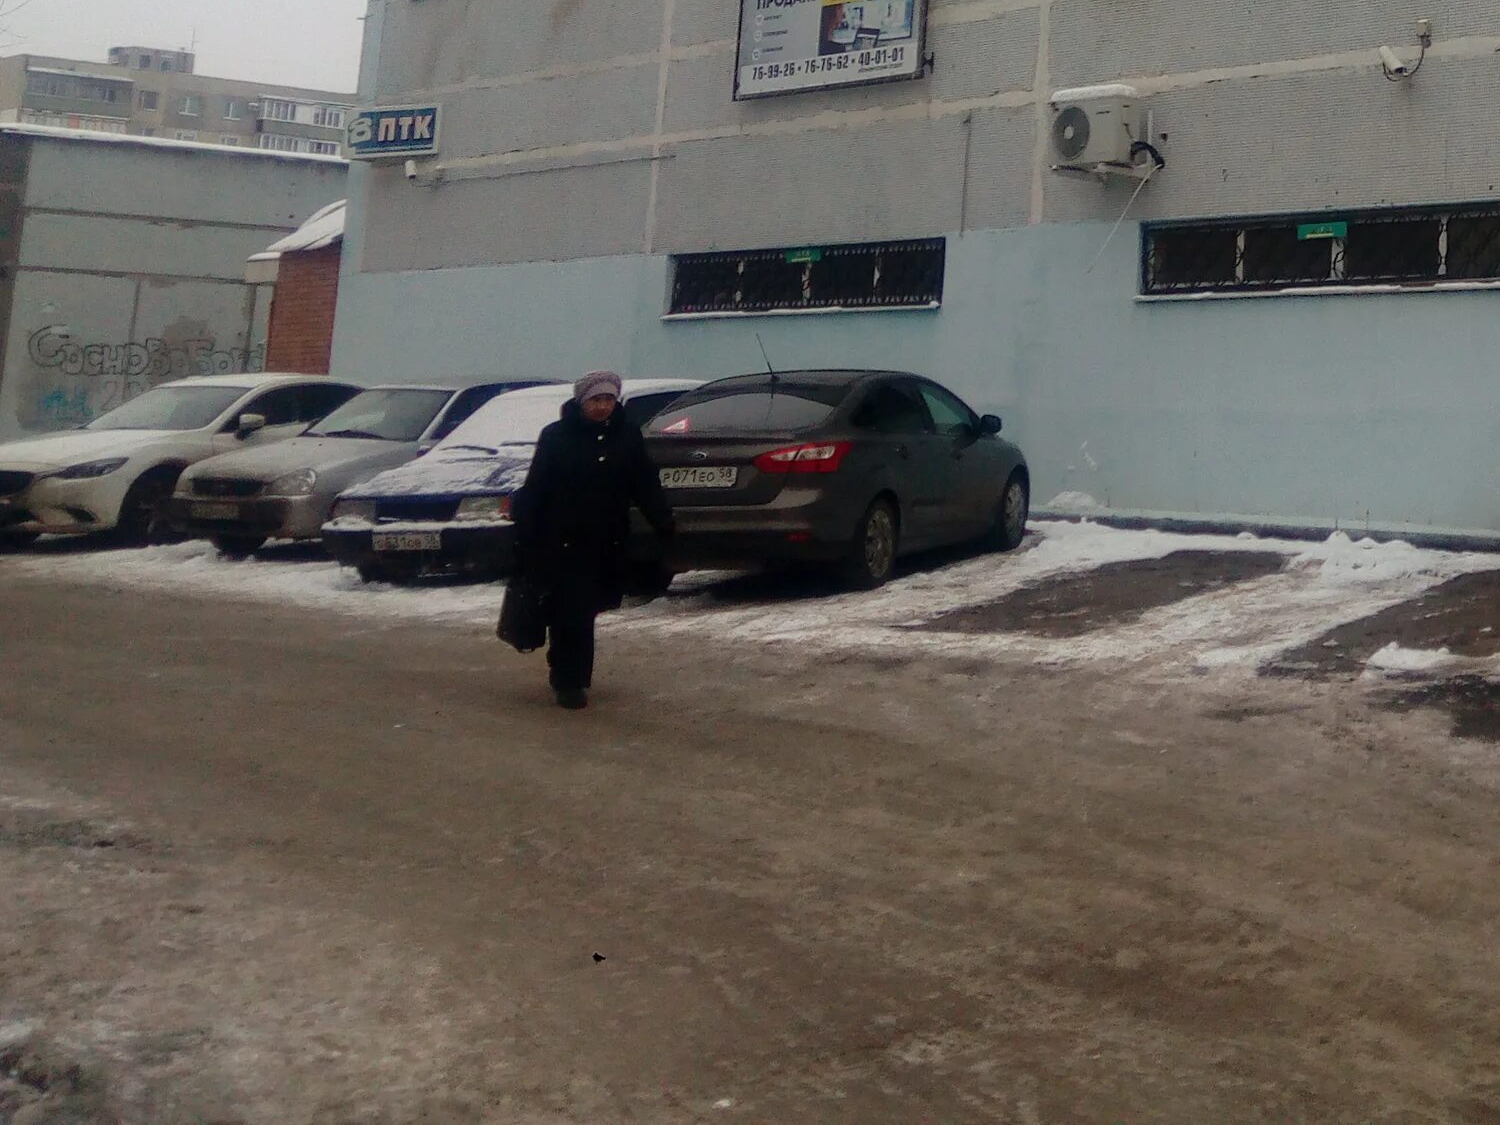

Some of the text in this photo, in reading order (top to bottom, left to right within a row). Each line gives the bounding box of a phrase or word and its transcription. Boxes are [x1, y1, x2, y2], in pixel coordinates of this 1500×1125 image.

[752, 62, 795, 81] 76-99-26
[804, 54, 849, 74] 76-76-62
[857, 46, 905, 65] 40-01-01
[377, 115, 433, 142] ПТК
